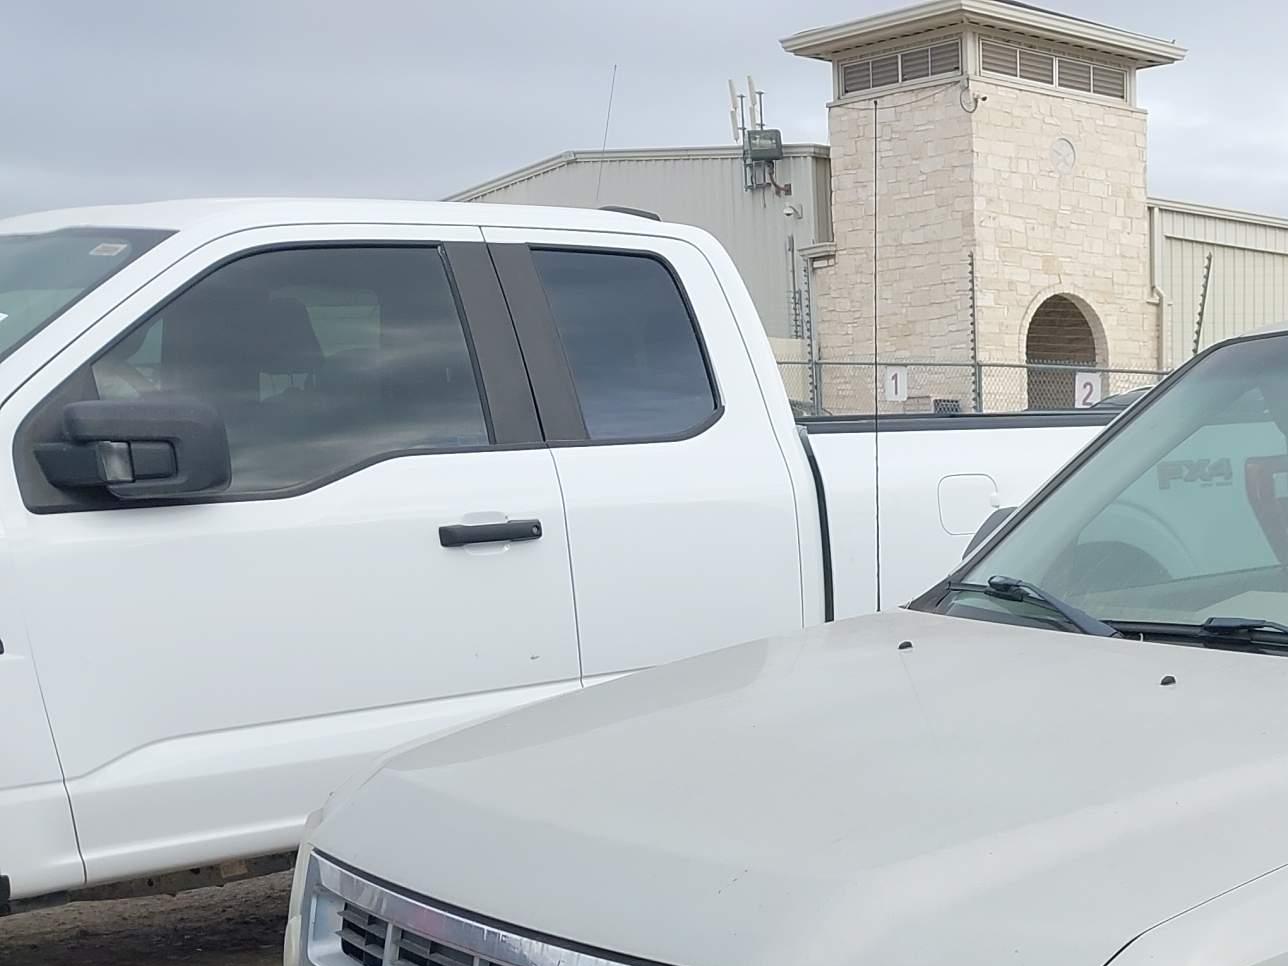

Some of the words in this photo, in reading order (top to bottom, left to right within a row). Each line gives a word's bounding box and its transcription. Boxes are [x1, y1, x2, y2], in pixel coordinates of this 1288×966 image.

[890, 372, 900, 396] 1
[1081, 381, 1095, 406] 2
[1157, 458, 1233, 490] FX4
